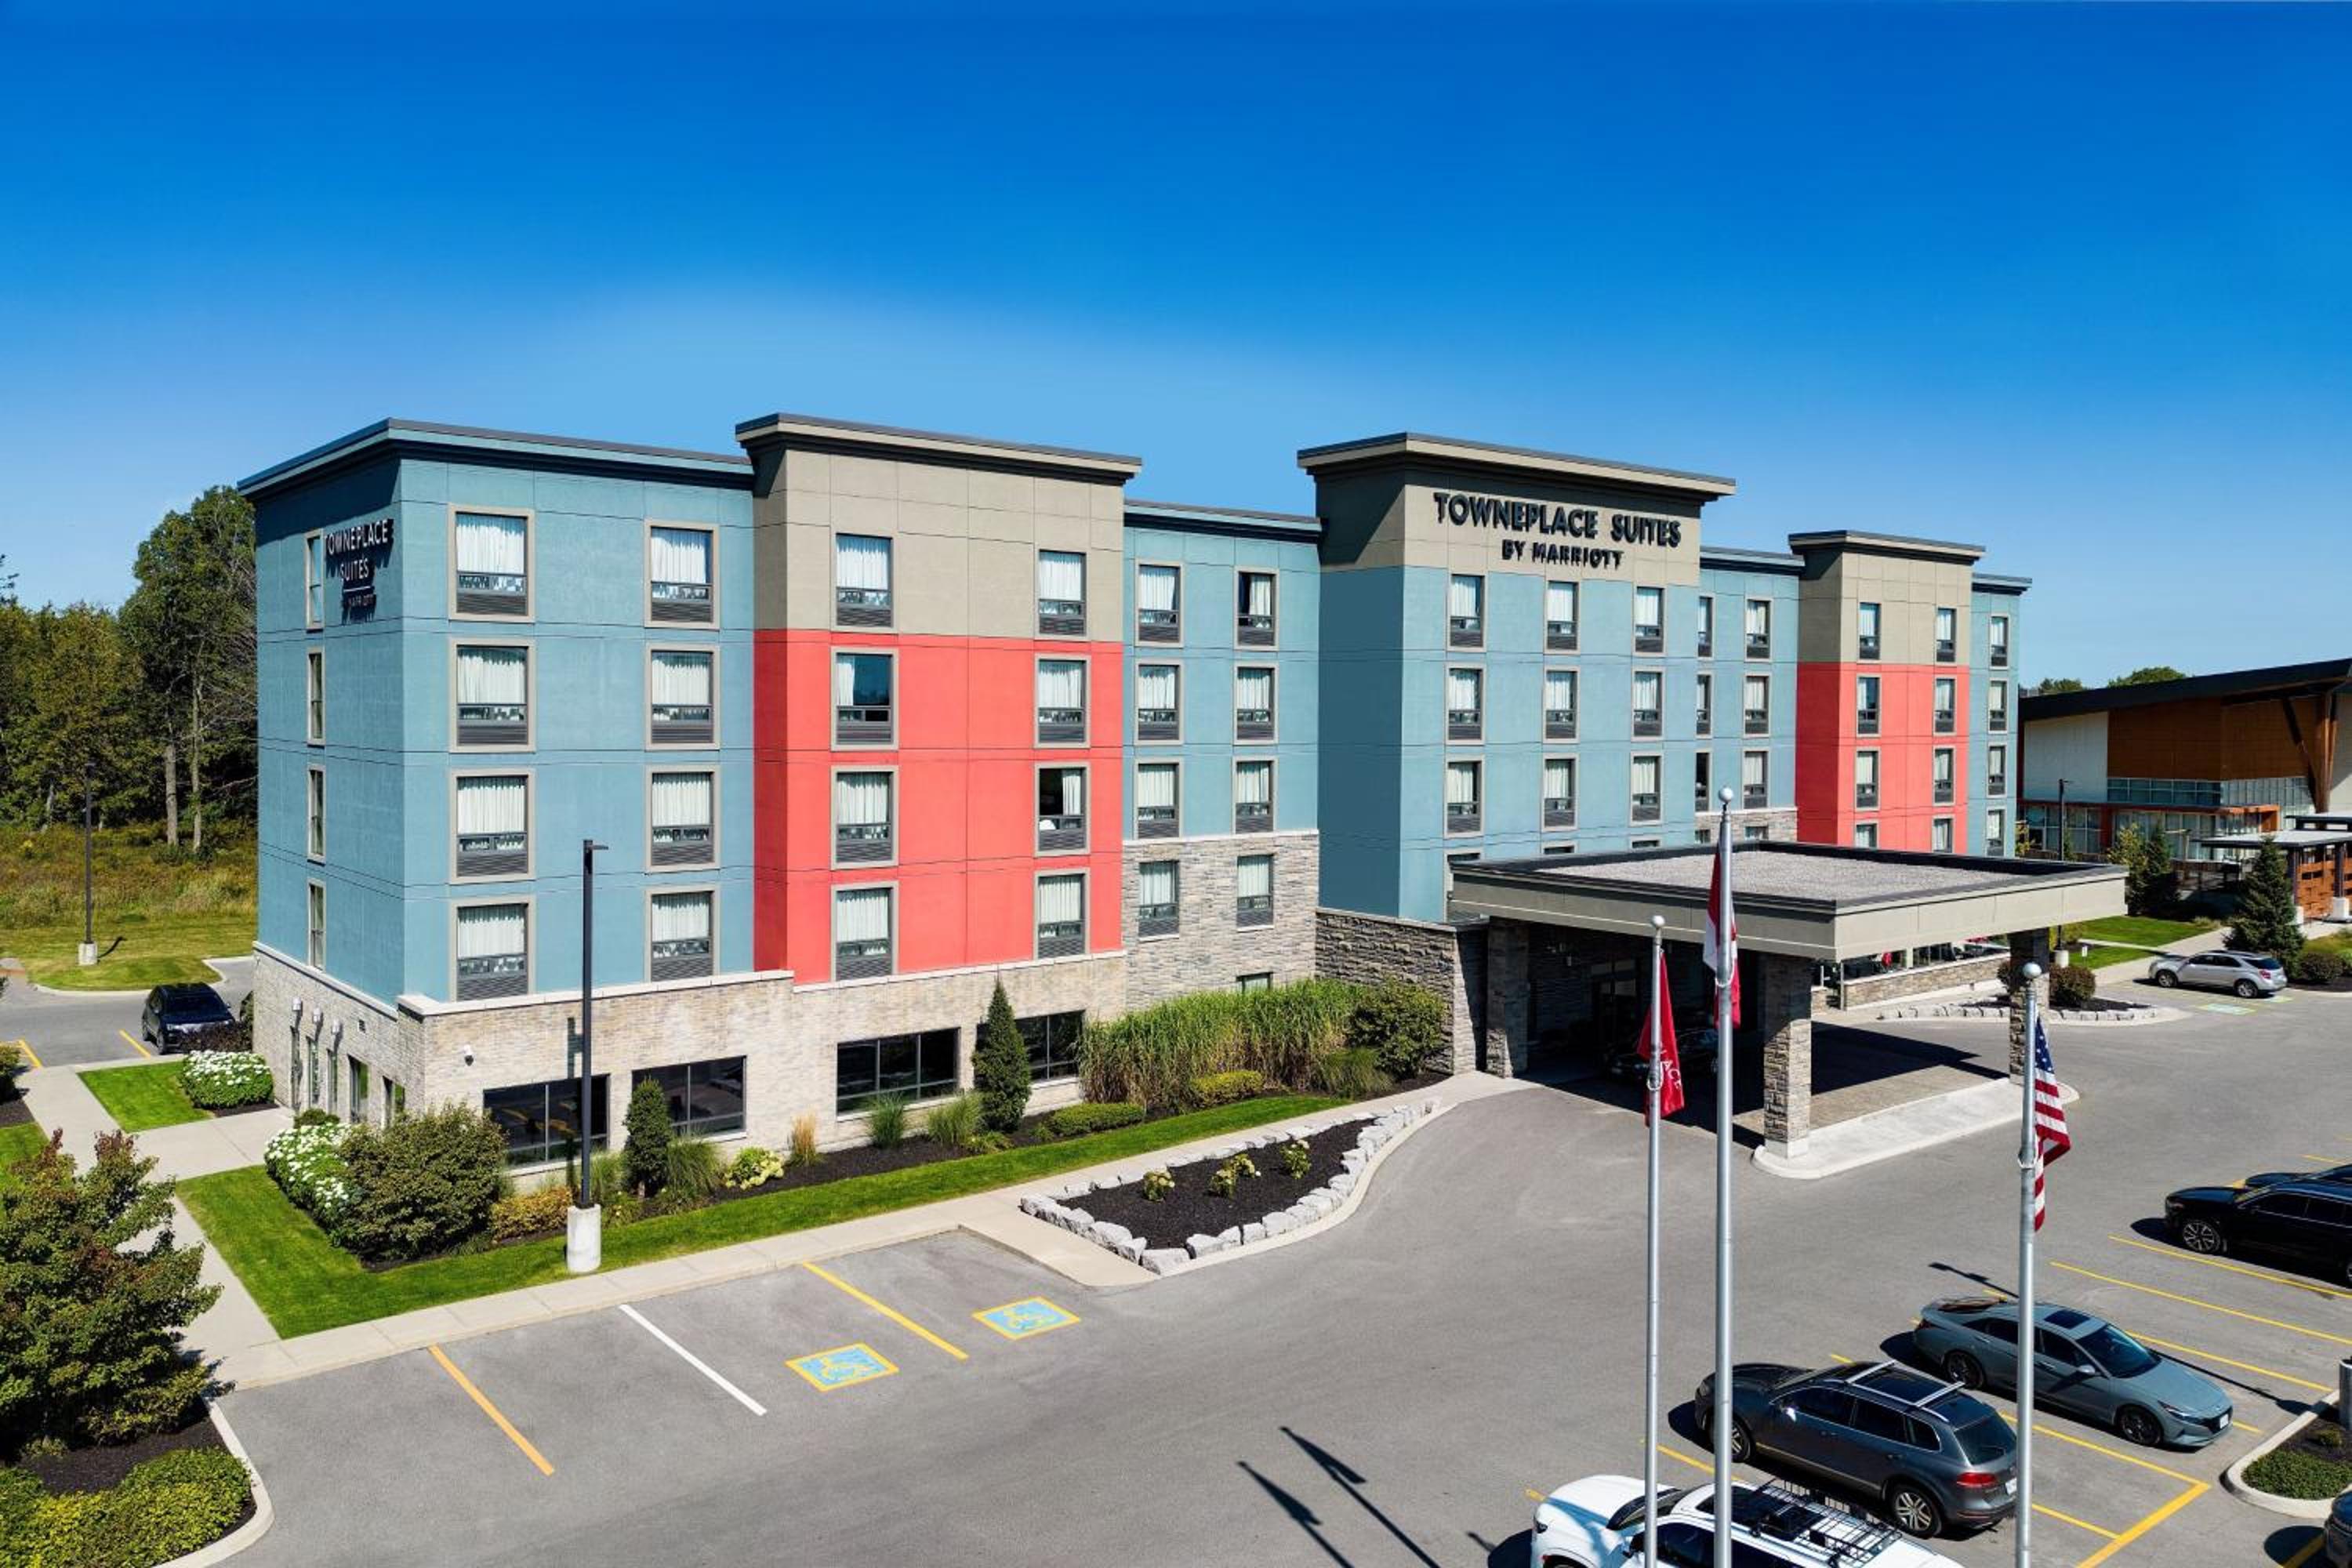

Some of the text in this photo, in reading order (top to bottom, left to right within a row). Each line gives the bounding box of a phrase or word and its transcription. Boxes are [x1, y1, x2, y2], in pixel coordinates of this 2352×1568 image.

[1434, 492, 1682, 548] TOWNEPLACE SUITES
[324, 519, 389, 555] TOWNEPLACE
[339, 557, 369, 581] SUITES
[1502, 539, 1624, 570] BY MARRIOTT
